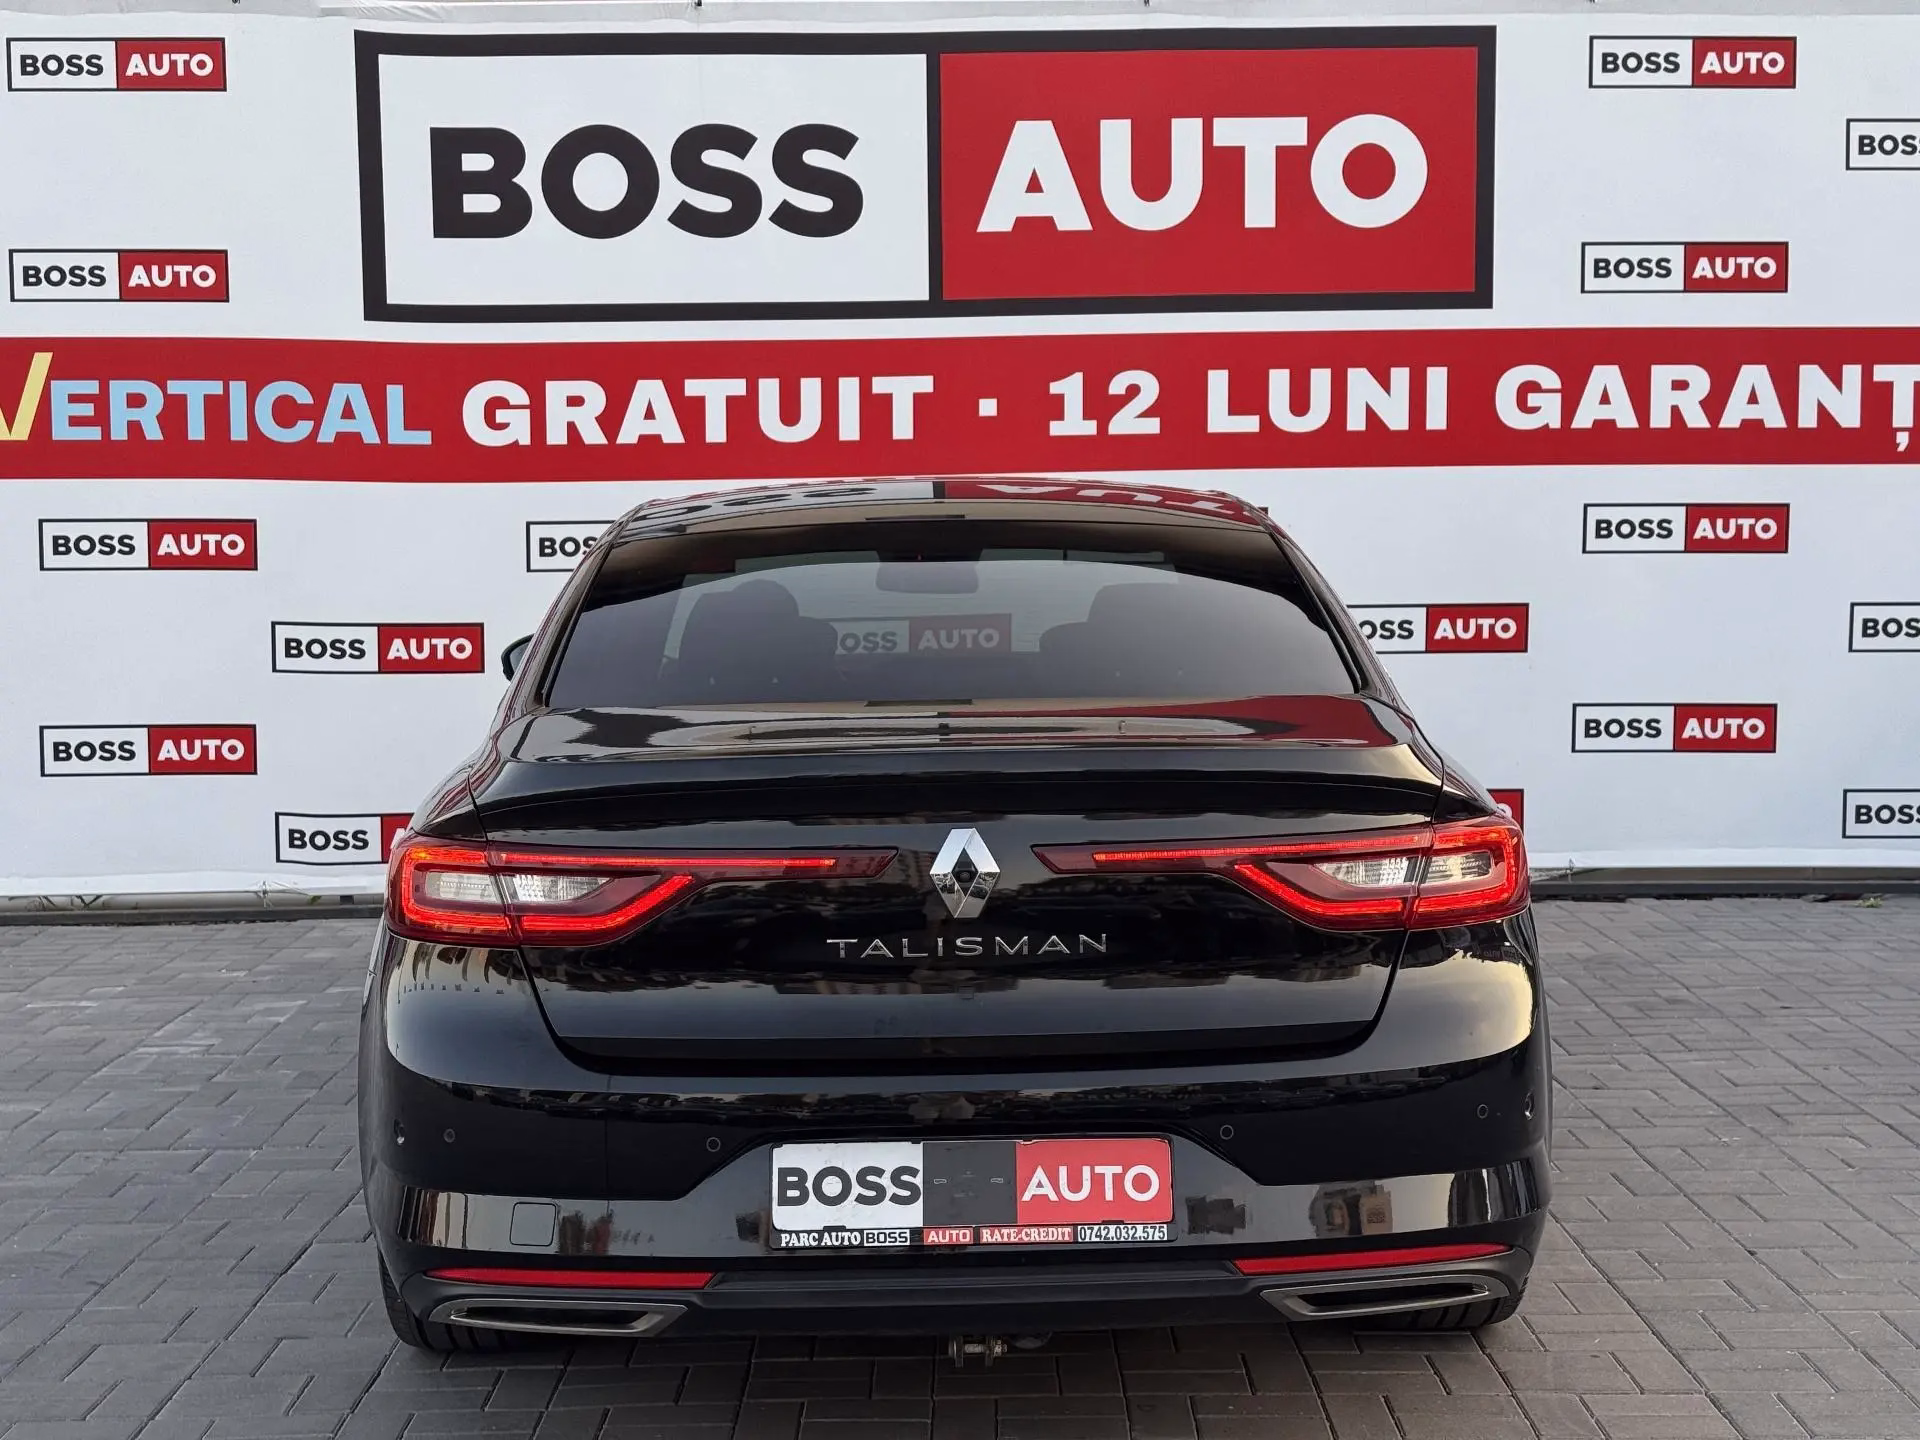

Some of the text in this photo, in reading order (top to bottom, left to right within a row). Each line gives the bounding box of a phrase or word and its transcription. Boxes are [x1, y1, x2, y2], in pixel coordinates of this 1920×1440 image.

[21, 53, 213, 77] BOSS AUTO
[1601, 52, 1785, 75] BOSS AUTO
[1858, 134, 1920, 155] BOS
[429, 114, 1428, 239] BOSS AUTO
[22, 264, 216, 288] BOSS AUTO
[1593, 256, 1777, 279] BOSS AUTO
[462, 375, 934, 447] GRATUIT
[1048, 370, 1160, 436] 12
[1207, 366, 1448, 434] LUNI
[1594, 517, 1778, 540] BOSS AUTO
[52, 533, 246, 556] BOSS AUTO
[839, 627, 1000, 653] OSS AUTO
[1358, 617, 1517, 640] OSS AUTO
[284, 637, 473, 660] BOSS AUTO
[1584, 717, 1766, 740] BOSS AUTO
[52, 738, 245, 762] BOSS AUTO
[288, 829, 370, 851] BOSS
[827, 933, 1107, 958] TALISMAN
[777, 1164, 1160, 1207] BOSS AUTO
[780, 1233, 819, 1247] PARC
[821, 1231, 861, 1246] AUTO
[865, 1230, 909, 1244] BOSS
[927, 1229, 971, 1243] AUTO
[1078, 1225, 1166, 1241] 0742.032.575
